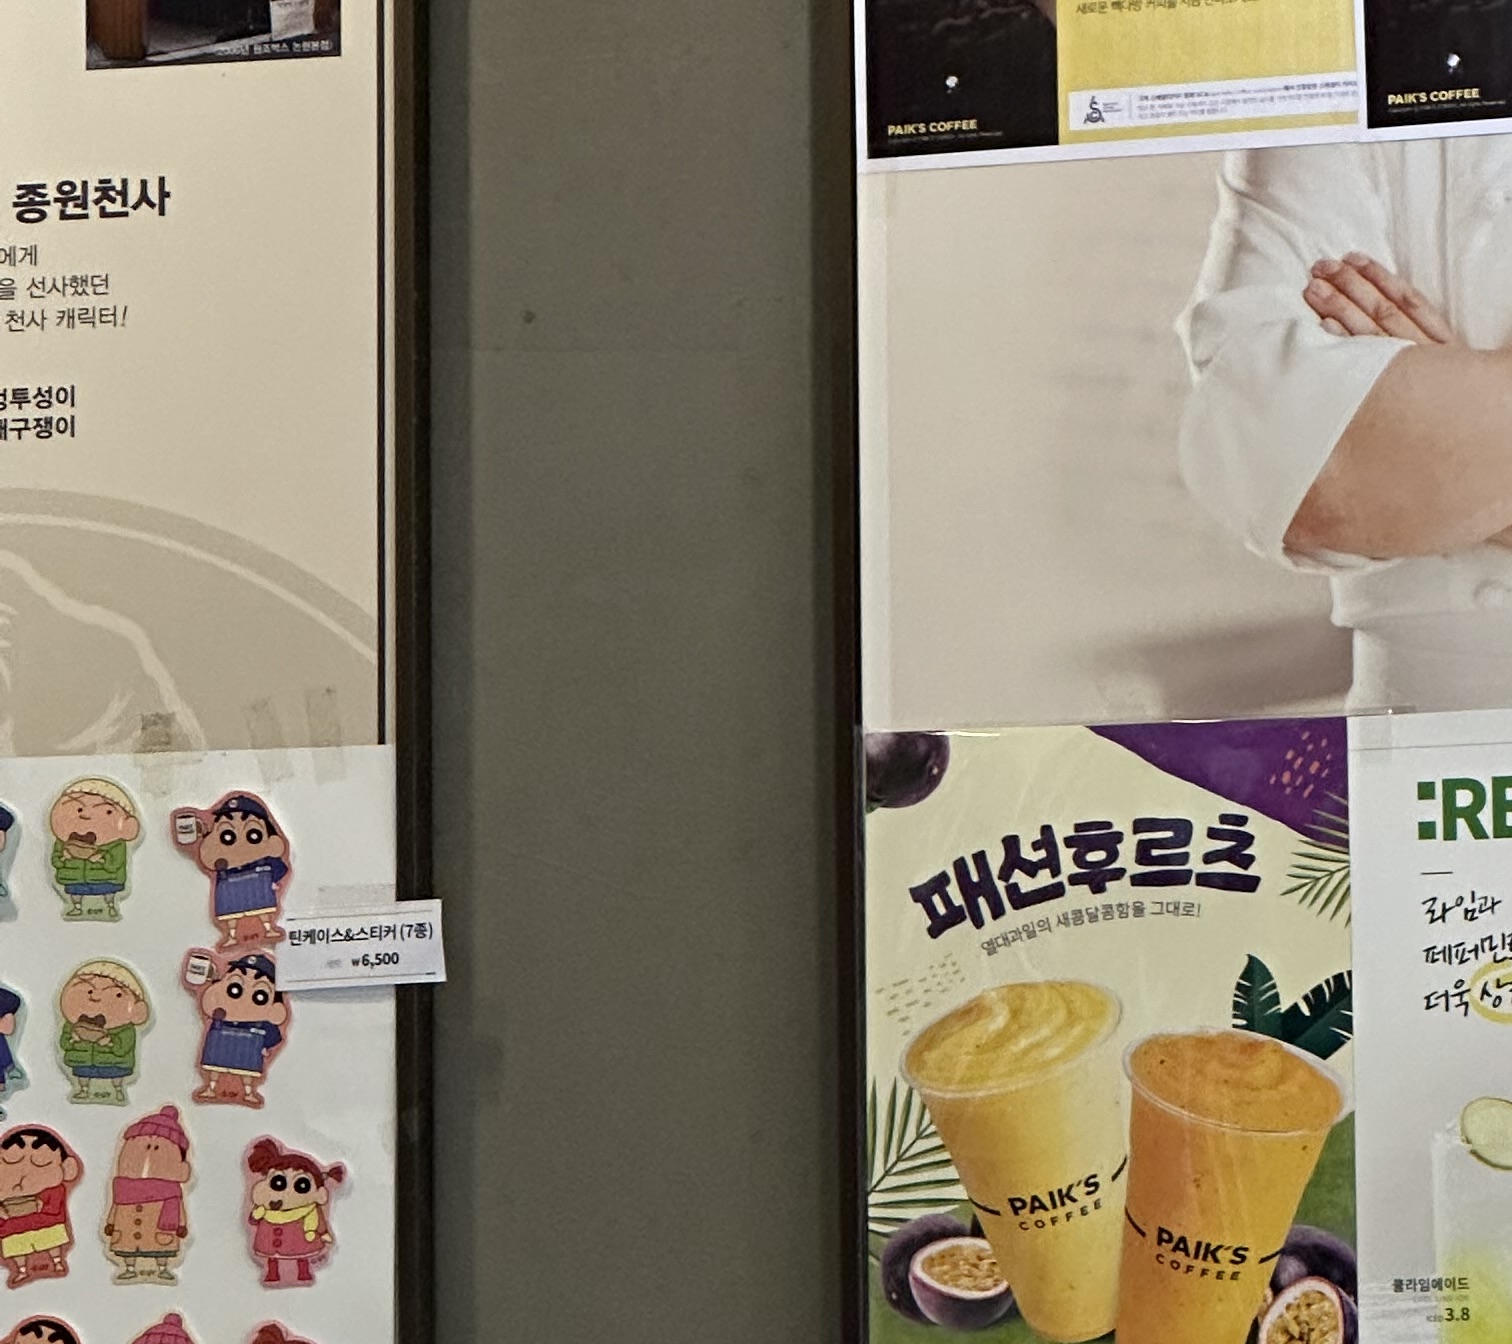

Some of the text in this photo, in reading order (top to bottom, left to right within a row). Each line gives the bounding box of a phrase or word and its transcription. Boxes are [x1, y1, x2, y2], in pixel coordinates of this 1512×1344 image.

[1430, 87, 1480, 102] COFFEE
[928, 118, 978, 132] COFFEE
[12, 175, 172, 225] 종원천사
[26, 273, 110, 299] 선사했던
[5, 304, 128, 332] 천사 캐릭터!
[908, 812, 1262, 940] 패션후르츠
[1055, 899, 1146, 929] 새콤달콤함을
[1420, 890, 1502, 925] 라임과
[288, 921, 433, 947] 틴케이스&스티커 (7종)
[1423, 978, 1472, 1017] 더욱
[1018, 1197, 1103, 1231] COFFEE
[1154, 1253, 1242, 1281] COFFEE
[1445, 1306, 1471, 1322] 3.8
